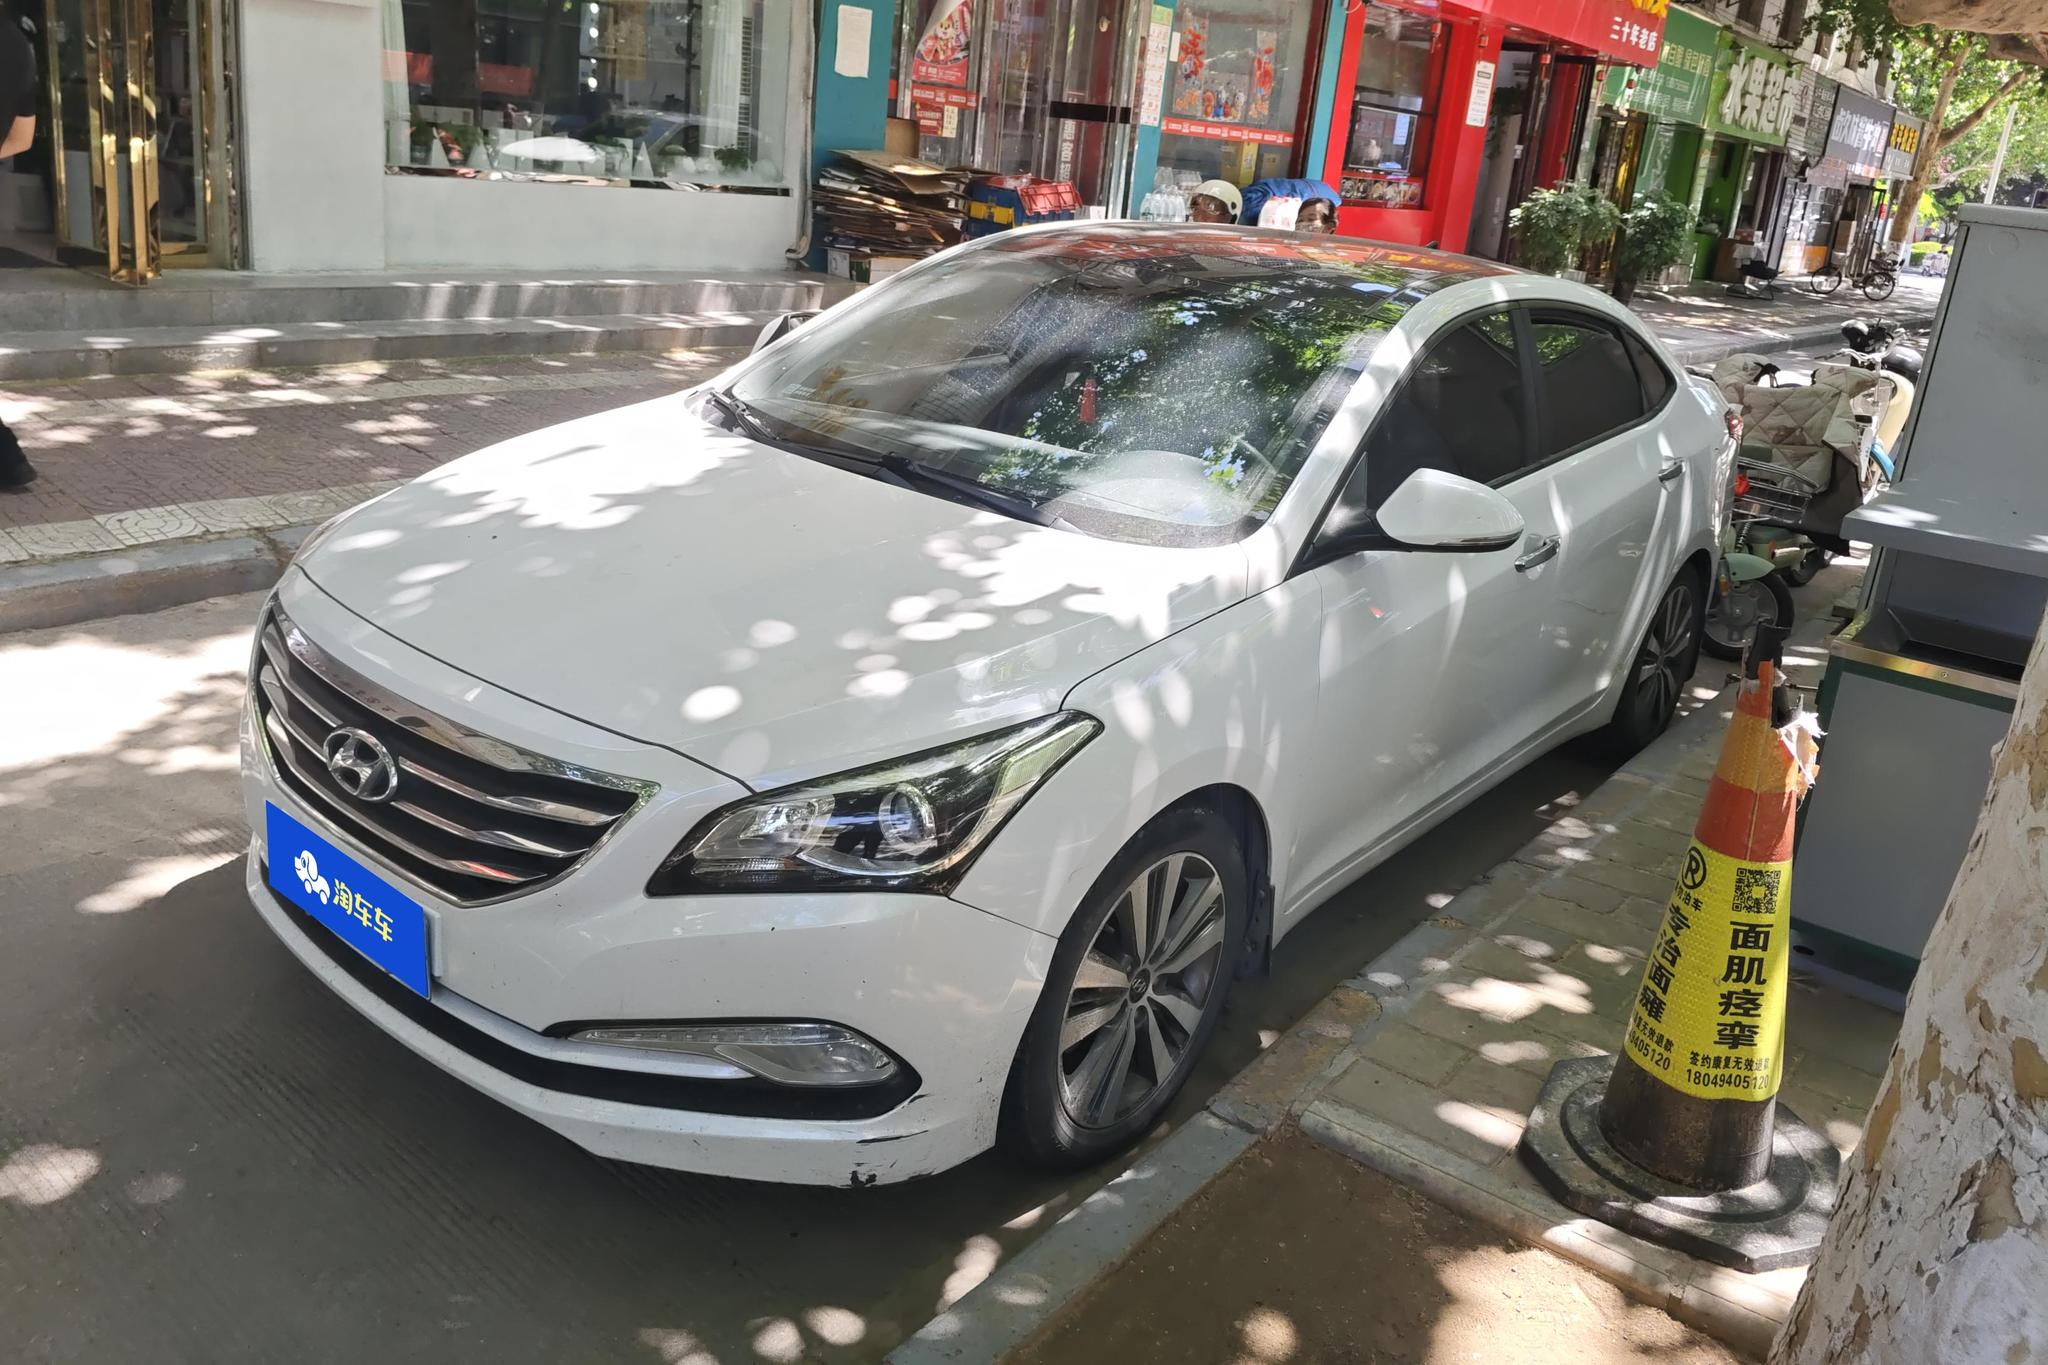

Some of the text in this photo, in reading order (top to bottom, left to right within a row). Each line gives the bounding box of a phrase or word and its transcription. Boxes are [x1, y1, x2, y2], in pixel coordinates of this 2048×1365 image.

[1609, 16, 1658, 52] 三十年老店
[1721, 46, 1801, 137] 水果超市
[1713, 920, 1774, 1050] 面肌痉挛
[1686, 1068, 1769, 1090] 18049405120
[1689, 1050, 1770, 1072] 签约康复无效退款
